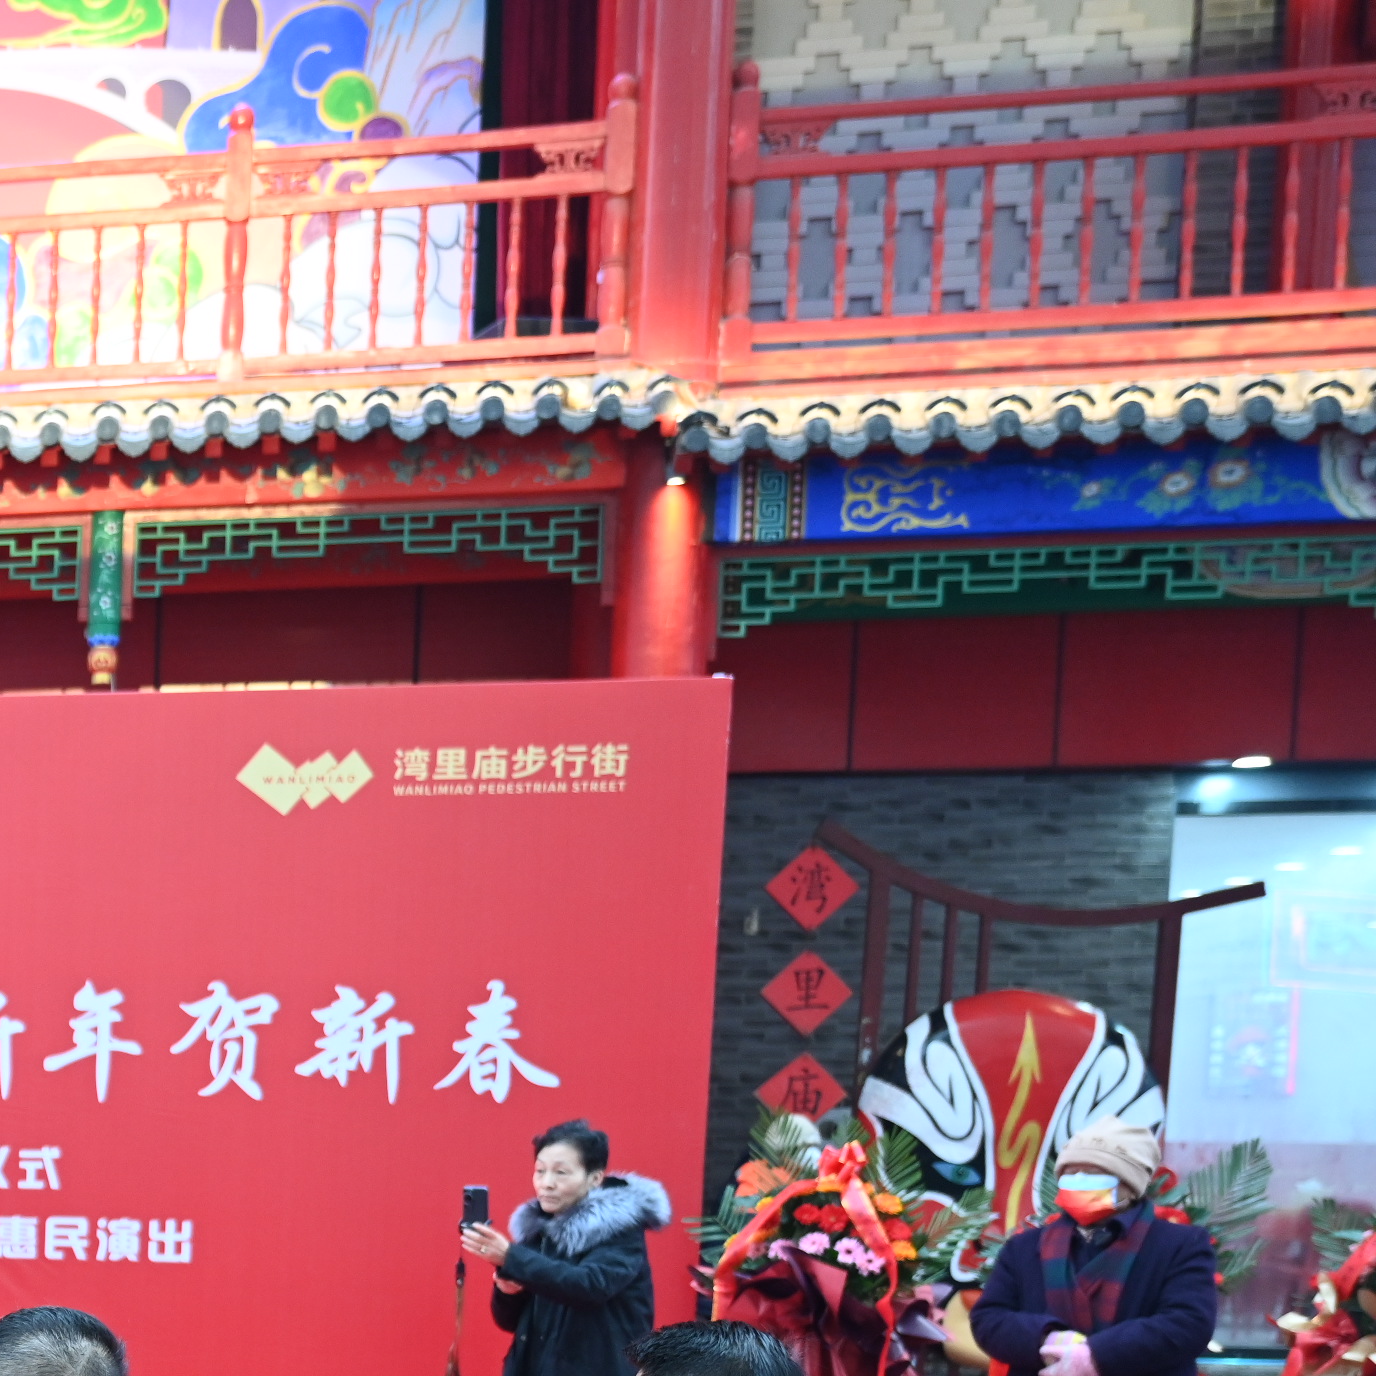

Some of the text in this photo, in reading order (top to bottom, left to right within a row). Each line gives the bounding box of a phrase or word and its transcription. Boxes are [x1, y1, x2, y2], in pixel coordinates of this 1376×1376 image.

[393, 743, 630, 782] 湾里庙步行街
[393, 779, 627, 798] WANLIMIAO PEDESTRIAN STREET
